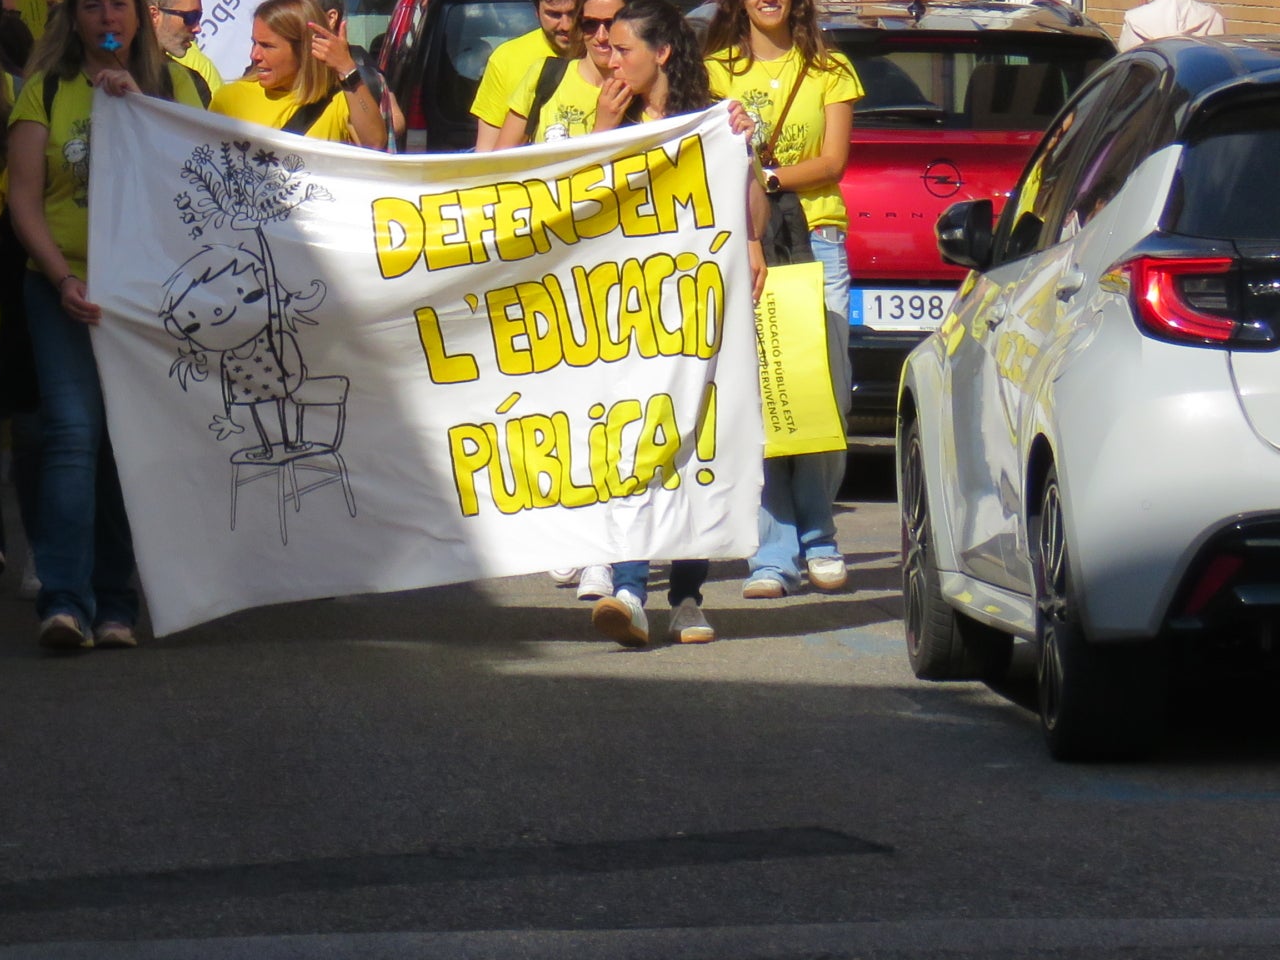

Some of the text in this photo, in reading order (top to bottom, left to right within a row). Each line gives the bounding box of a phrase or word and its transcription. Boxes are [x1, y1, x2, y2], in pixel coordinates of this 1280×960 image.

[371, 134, 715, 279] DEFENSEM
[414, 231, 731, 384] L'EDUCACIÓ
[754, 313, 765, 346] MODE
[766, 292, 798, 434] L'EDUCACIÓ PÚBLICA ESTÀ
[852, 295, 944, 320] E 1398
[759, 347, 781, 433] SUPERVIVÈNCIA
